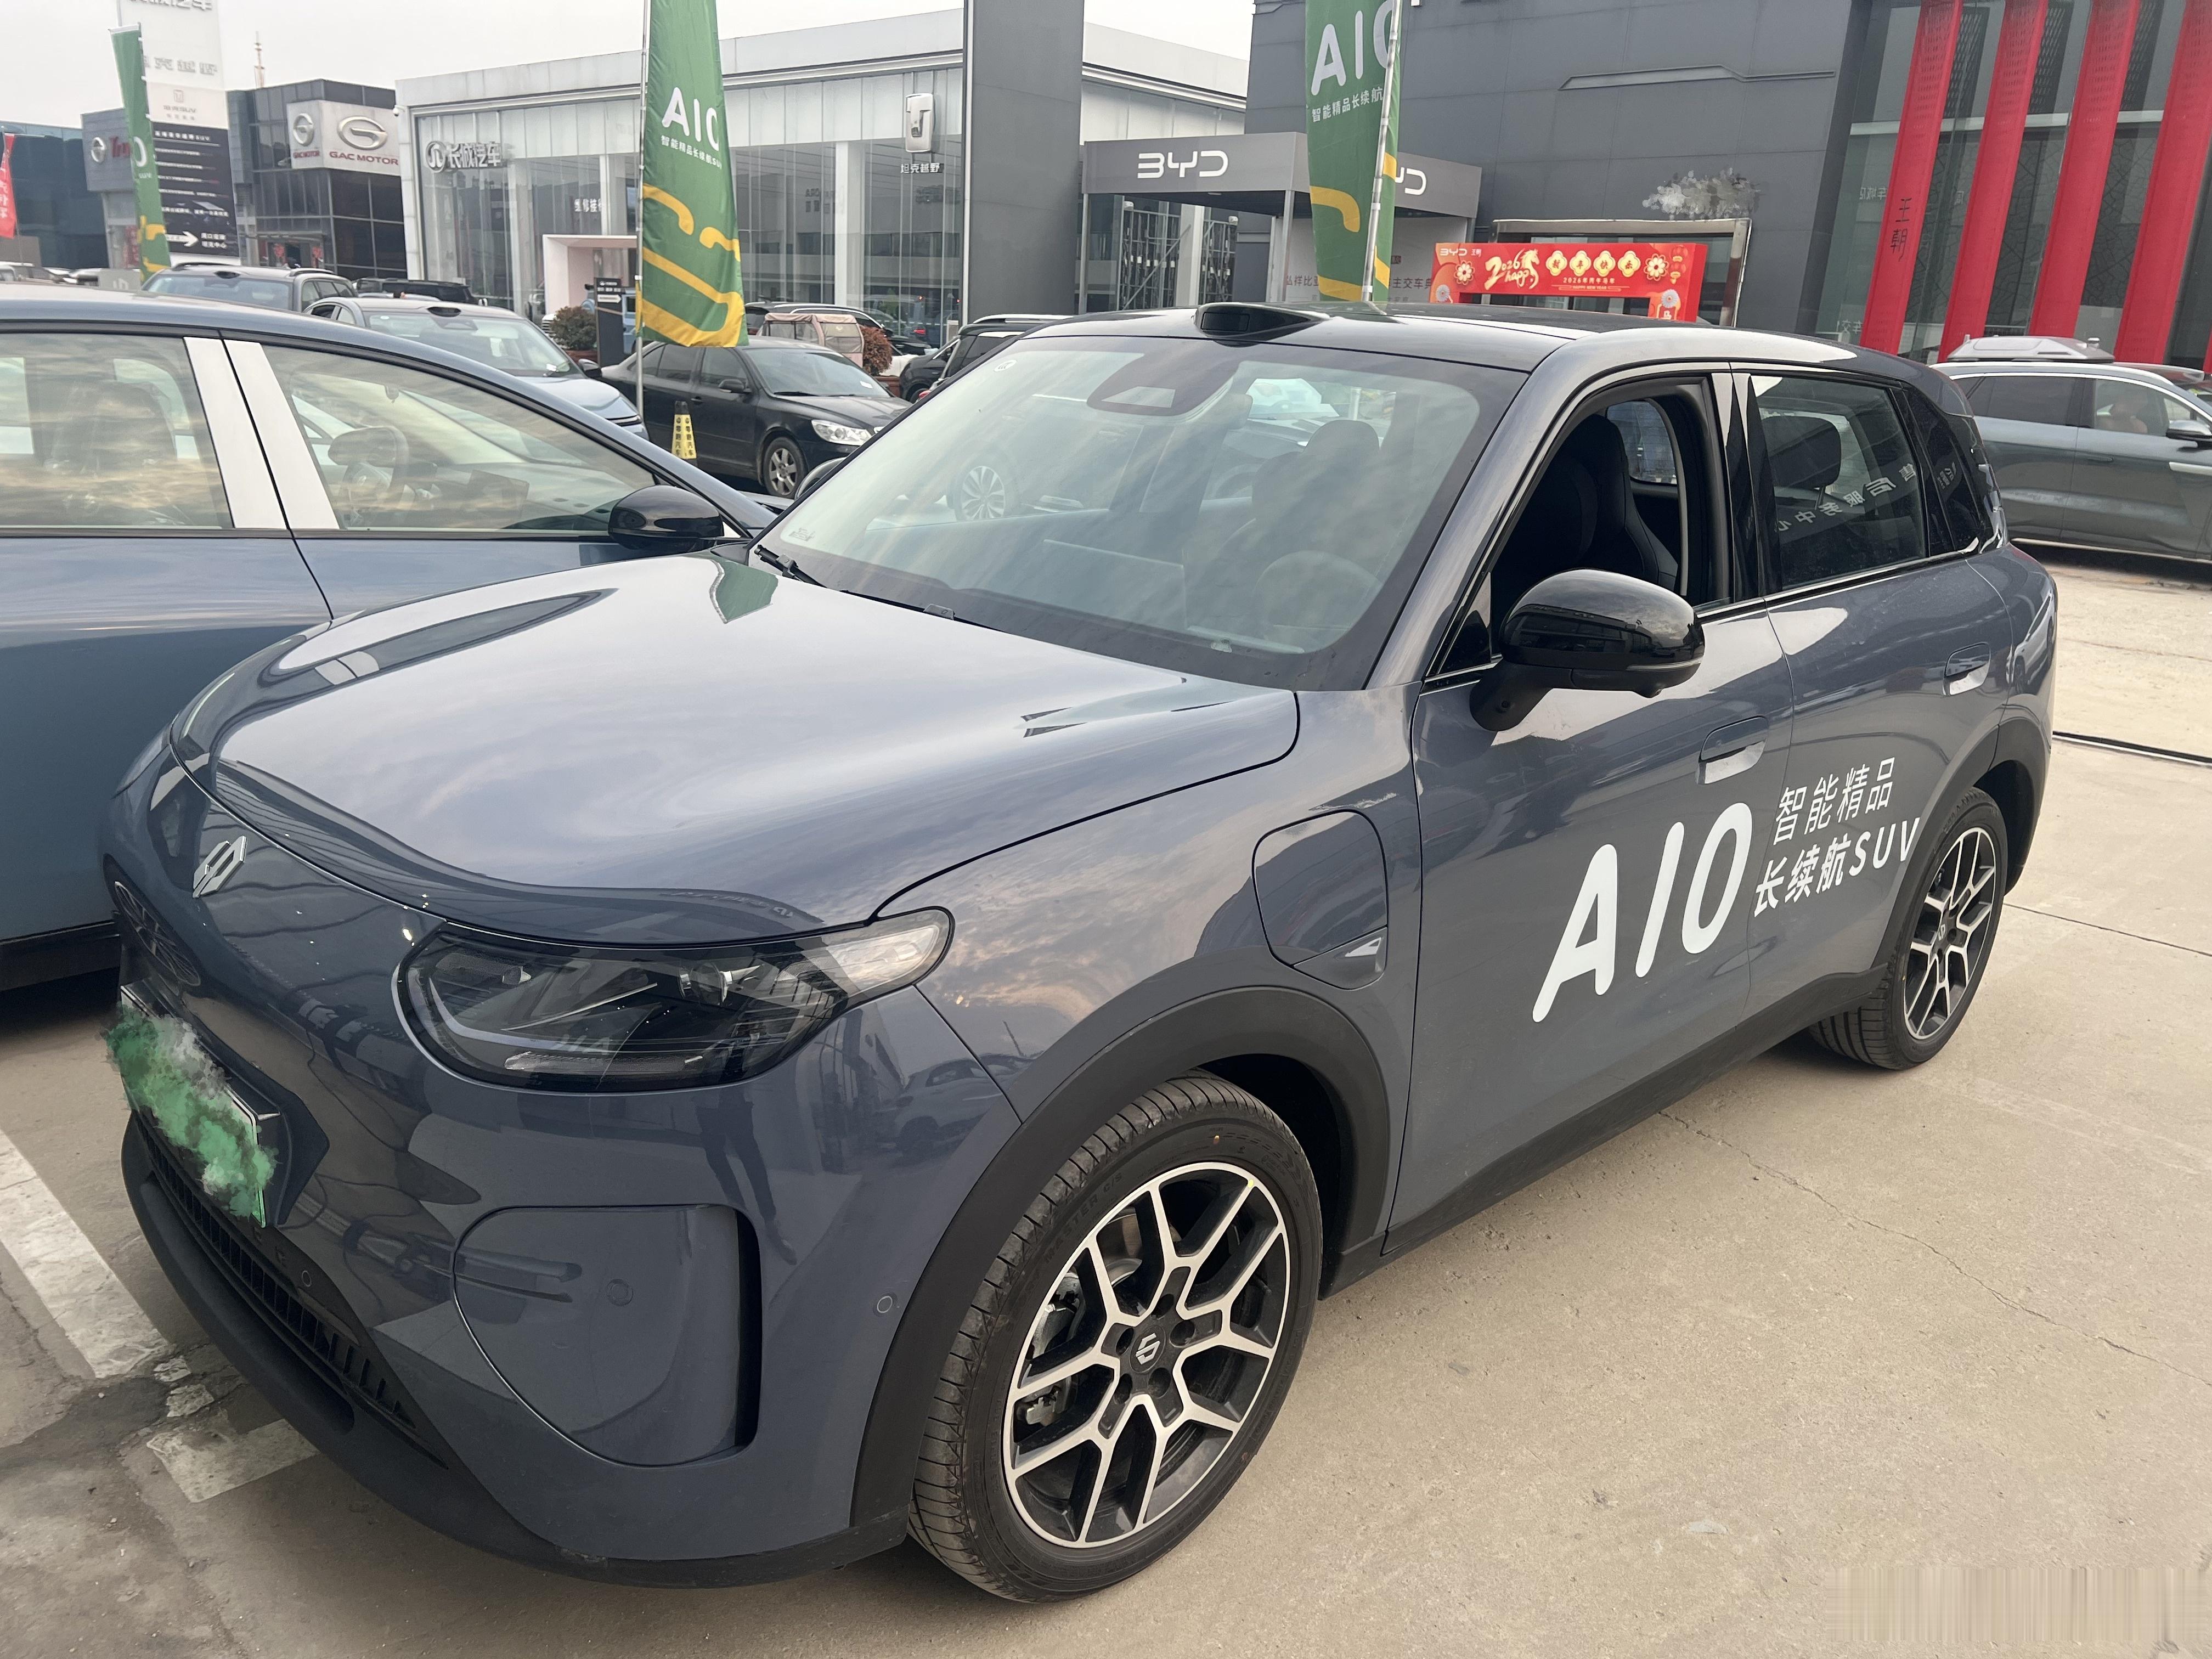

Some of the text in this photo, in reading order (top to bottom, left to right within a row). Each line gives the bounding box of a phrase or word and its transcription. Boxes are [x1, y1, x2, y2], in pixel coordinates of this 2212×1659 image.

[1312, 86, 1383, 123] 智能精品长续航
[330, 151, 399, 165] GAC MOTOR
[447, 141, 501, 168] 长城汽车
[900, 162, 940, 173] 坦克越野
[1137, 150, 1228, 179] BYD
[1891, 198, 1912, 262] 王朝
[1440, 248, 1468, 256] BYD
[1552, 259, 1633, 270] 新年快乐
[1484, 248, 1525, 290] 2026
[1771, 757, 1895, 845] 智能精品
[1753, 817, 1921, 918] 长续航SUV
[1532, 803, 1753, 1023] AIO
